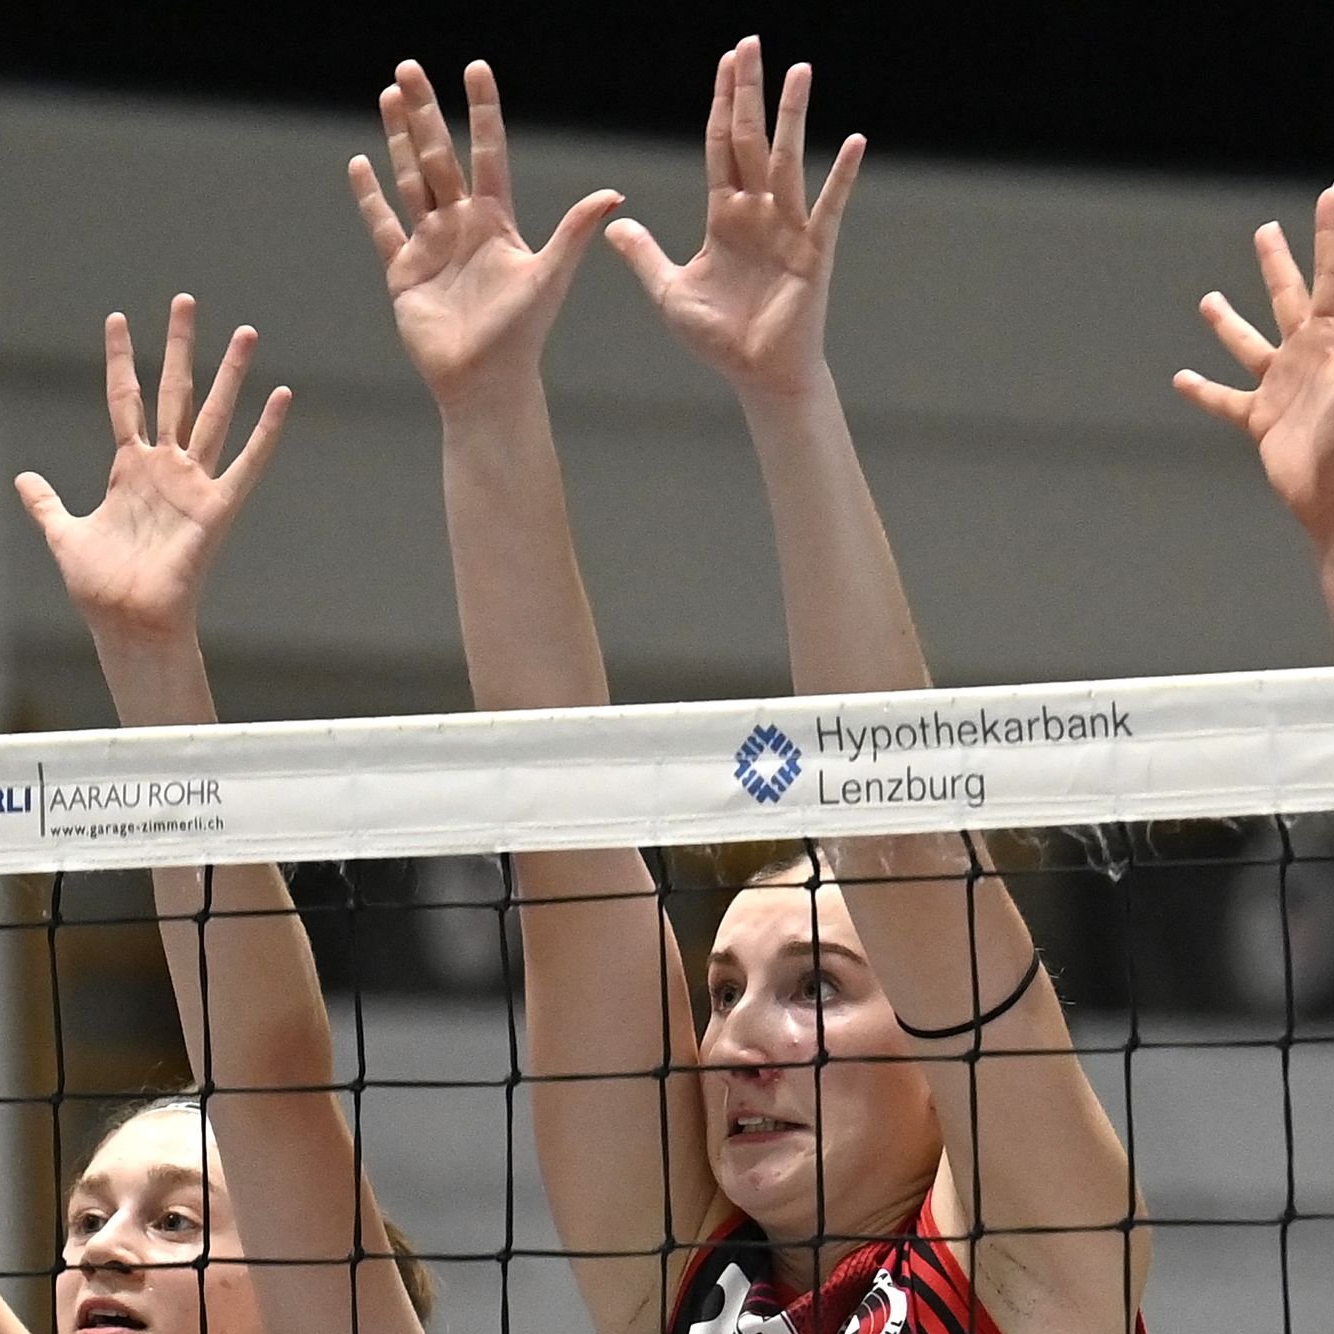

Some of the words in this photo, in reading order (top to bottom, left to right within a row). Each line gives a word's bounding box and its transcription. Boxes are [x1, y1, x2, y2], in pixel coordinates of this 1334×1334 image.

[816, 701, 1133, 762] Hypothekarbank
[49, 784, 141, 812] AARAU
[149, 779, 222, 808] ROHR
[819, 767, 986, 808] Lenzburg
[50, 817, 224, 840] www.garage-zimmerli.ch
